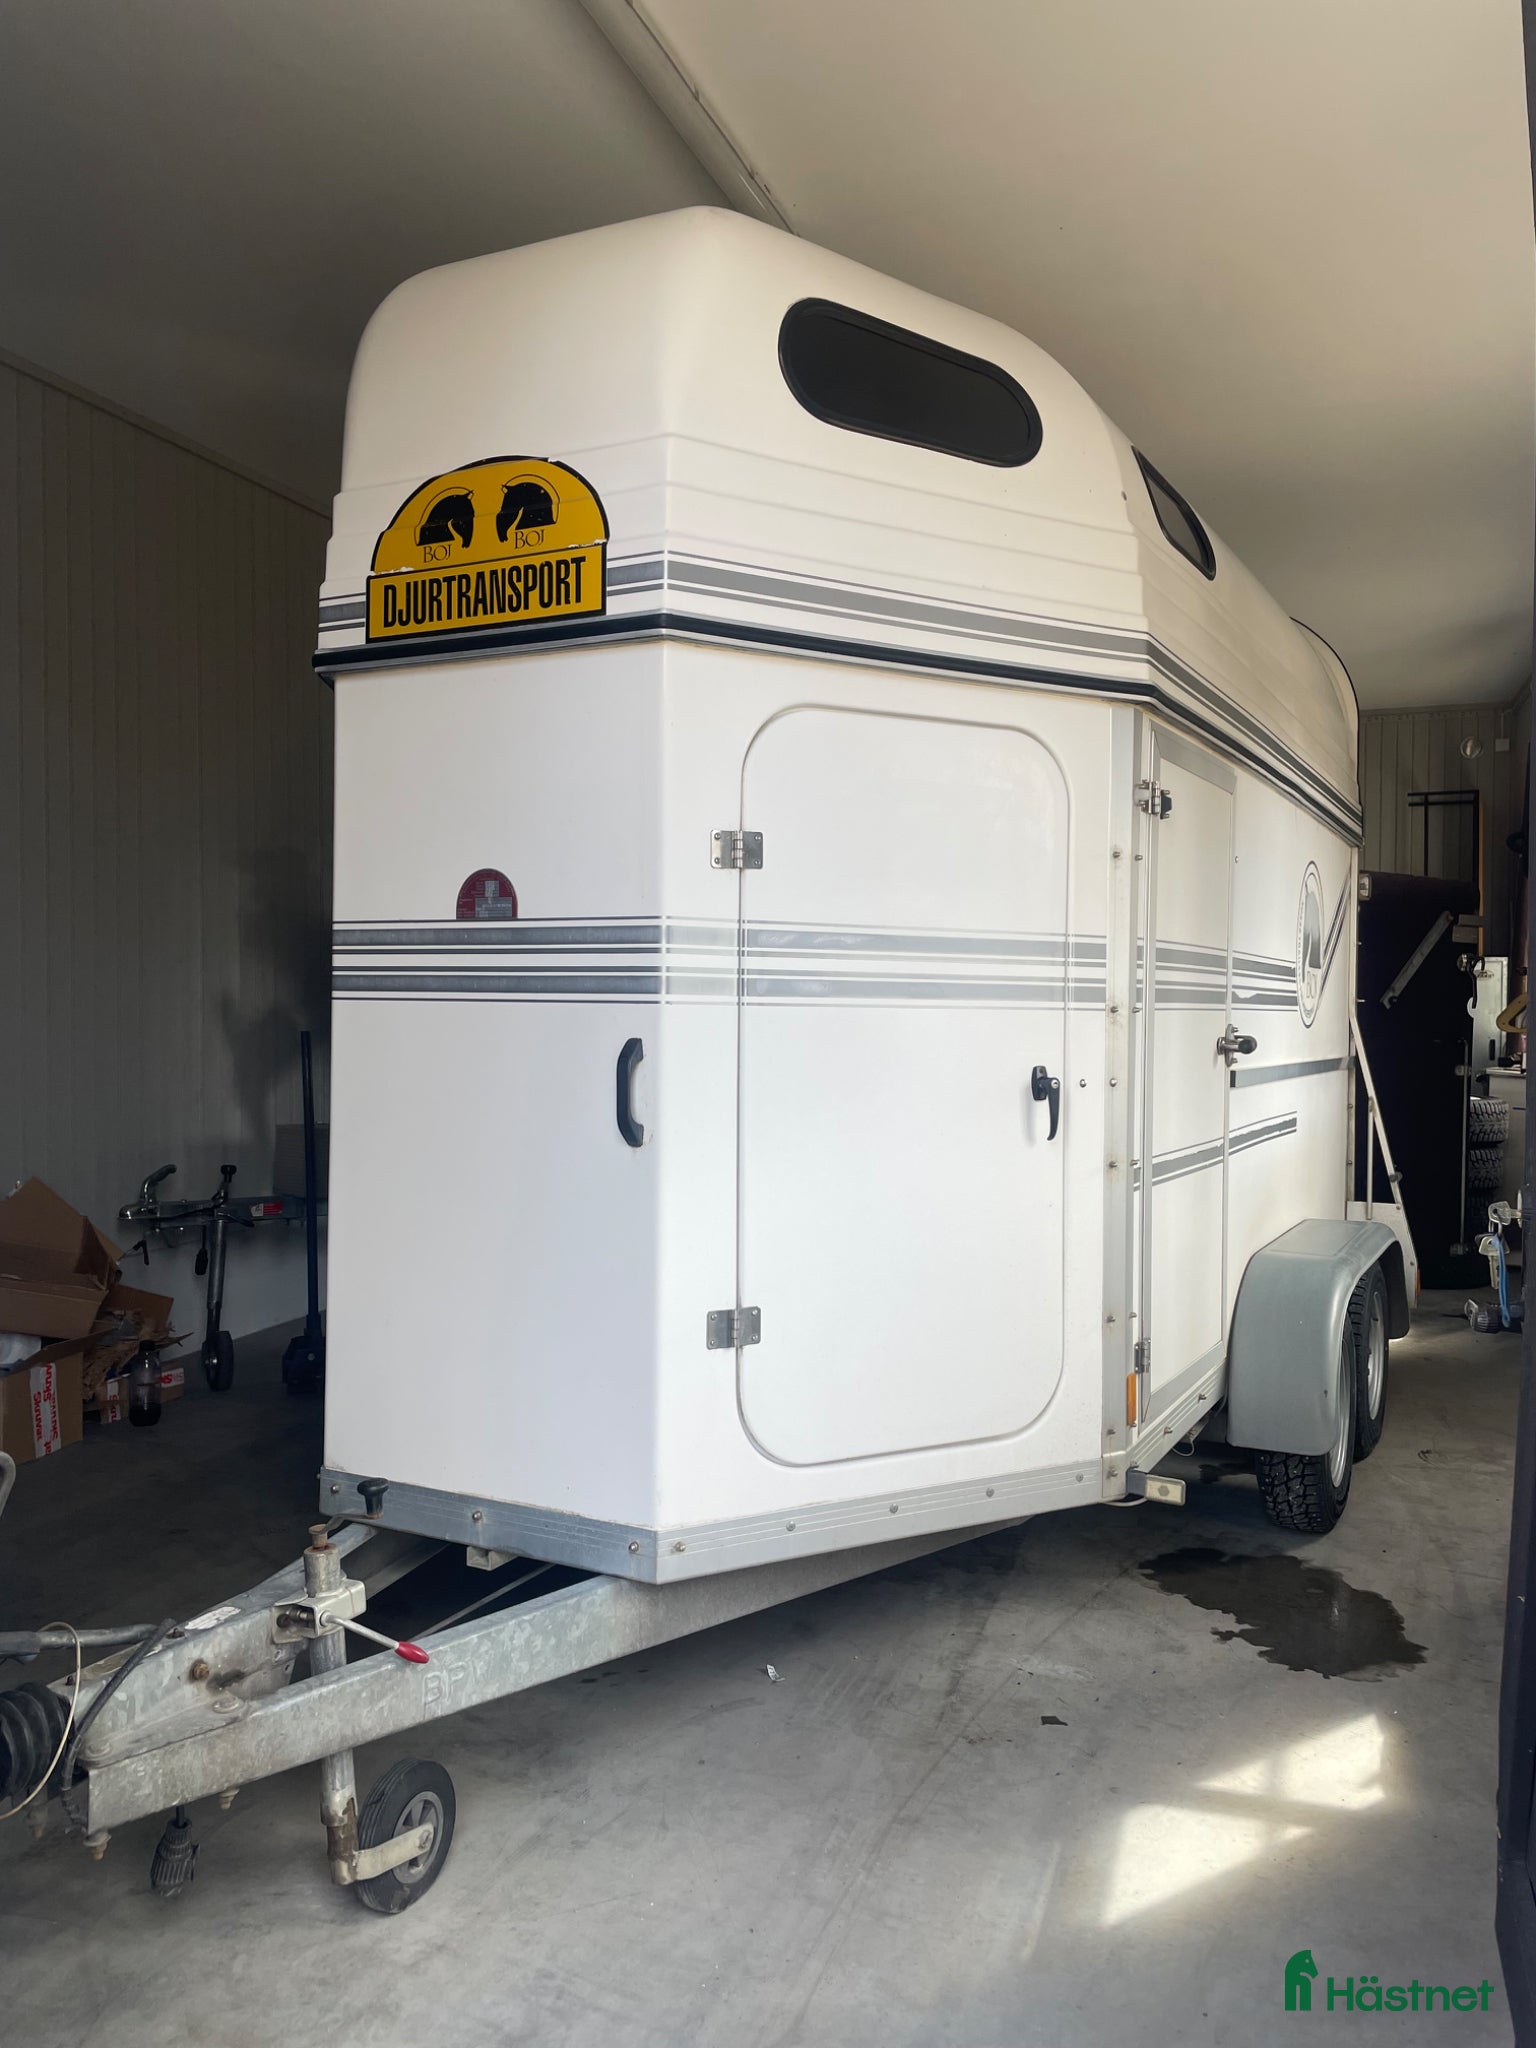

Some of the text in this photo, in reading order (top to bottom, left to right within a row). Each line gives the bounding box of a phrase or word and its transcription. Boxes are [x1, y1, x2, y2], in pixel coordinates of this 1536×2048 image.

[514, 529, 545, 549] BOJ
[423, 544, 451, 563] BOJ
[383, 556, 586, 629] DJURTRANSPORT
